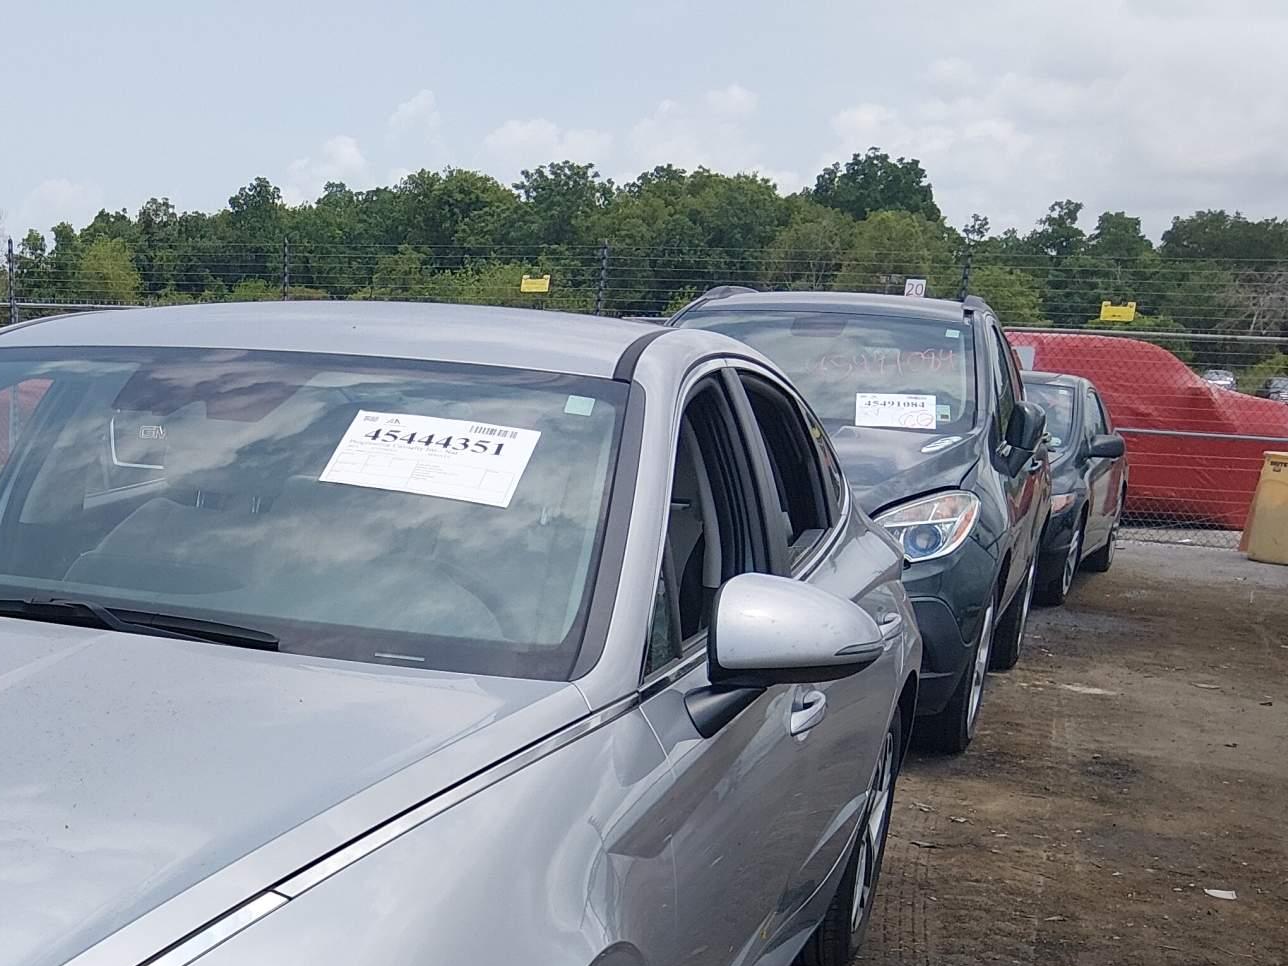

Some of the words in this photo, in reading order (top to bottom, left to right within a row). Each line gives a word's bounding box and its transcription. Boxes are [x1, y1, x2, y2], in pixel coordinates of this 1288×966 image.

[905, 283, 924, 296] 20
[863, 400, 925, 408] 45491084
[364, 428, 505, 456] 45444351
